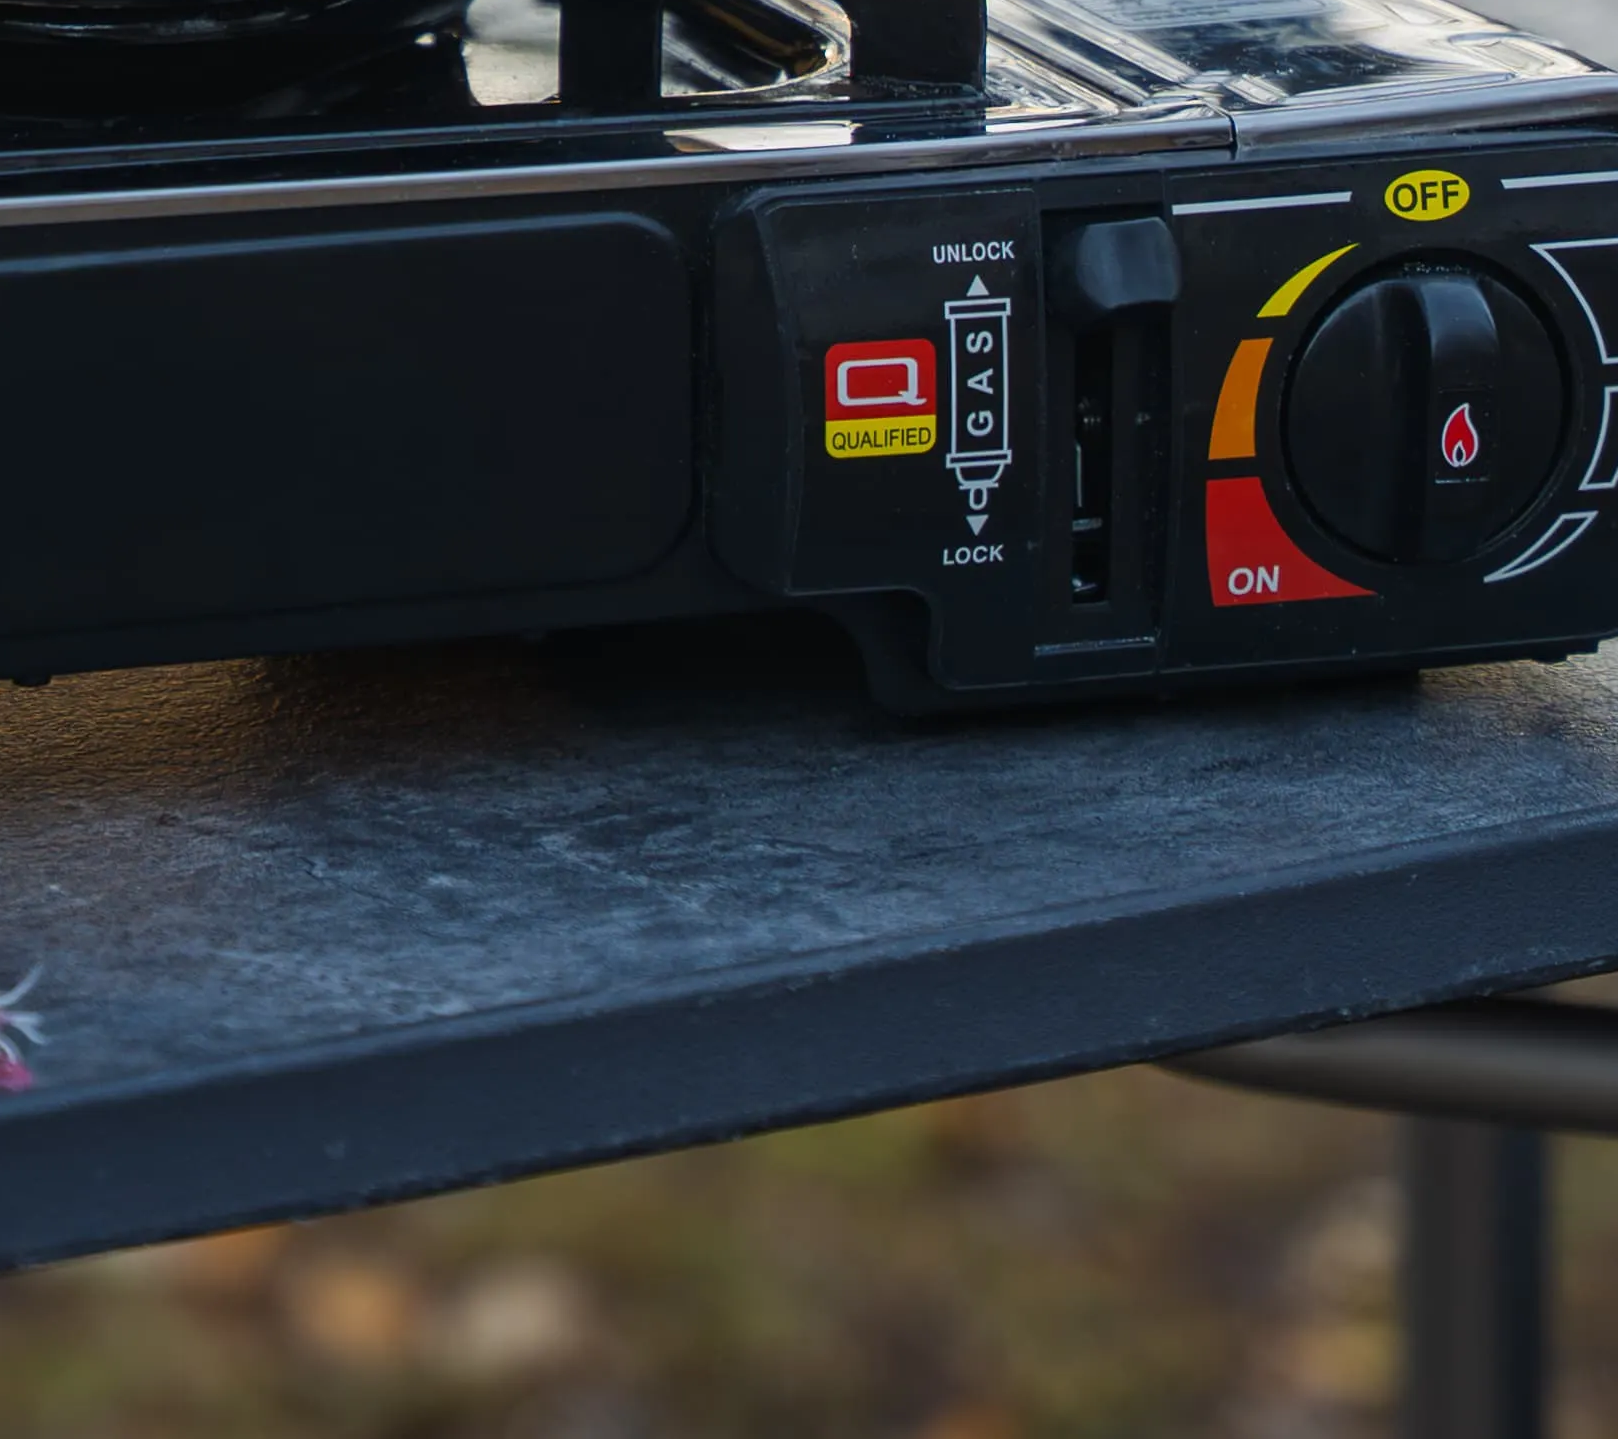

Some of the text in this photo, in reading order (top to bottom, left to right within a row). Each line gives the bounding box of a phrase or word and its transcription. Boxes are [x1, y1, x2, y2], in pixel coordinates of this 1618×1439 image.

[1393, 179, 1460, 213] OFF
[933, 241, 1014, 264] UNLOCK
[837, 357, 927, 407] Q
[966, 330, 994, 437] GAS
[832, 426, 932, 451] QUALIFIED
[943, 544, 1004, 565] LOCK
[1228, 565, 1280, 595] ON
